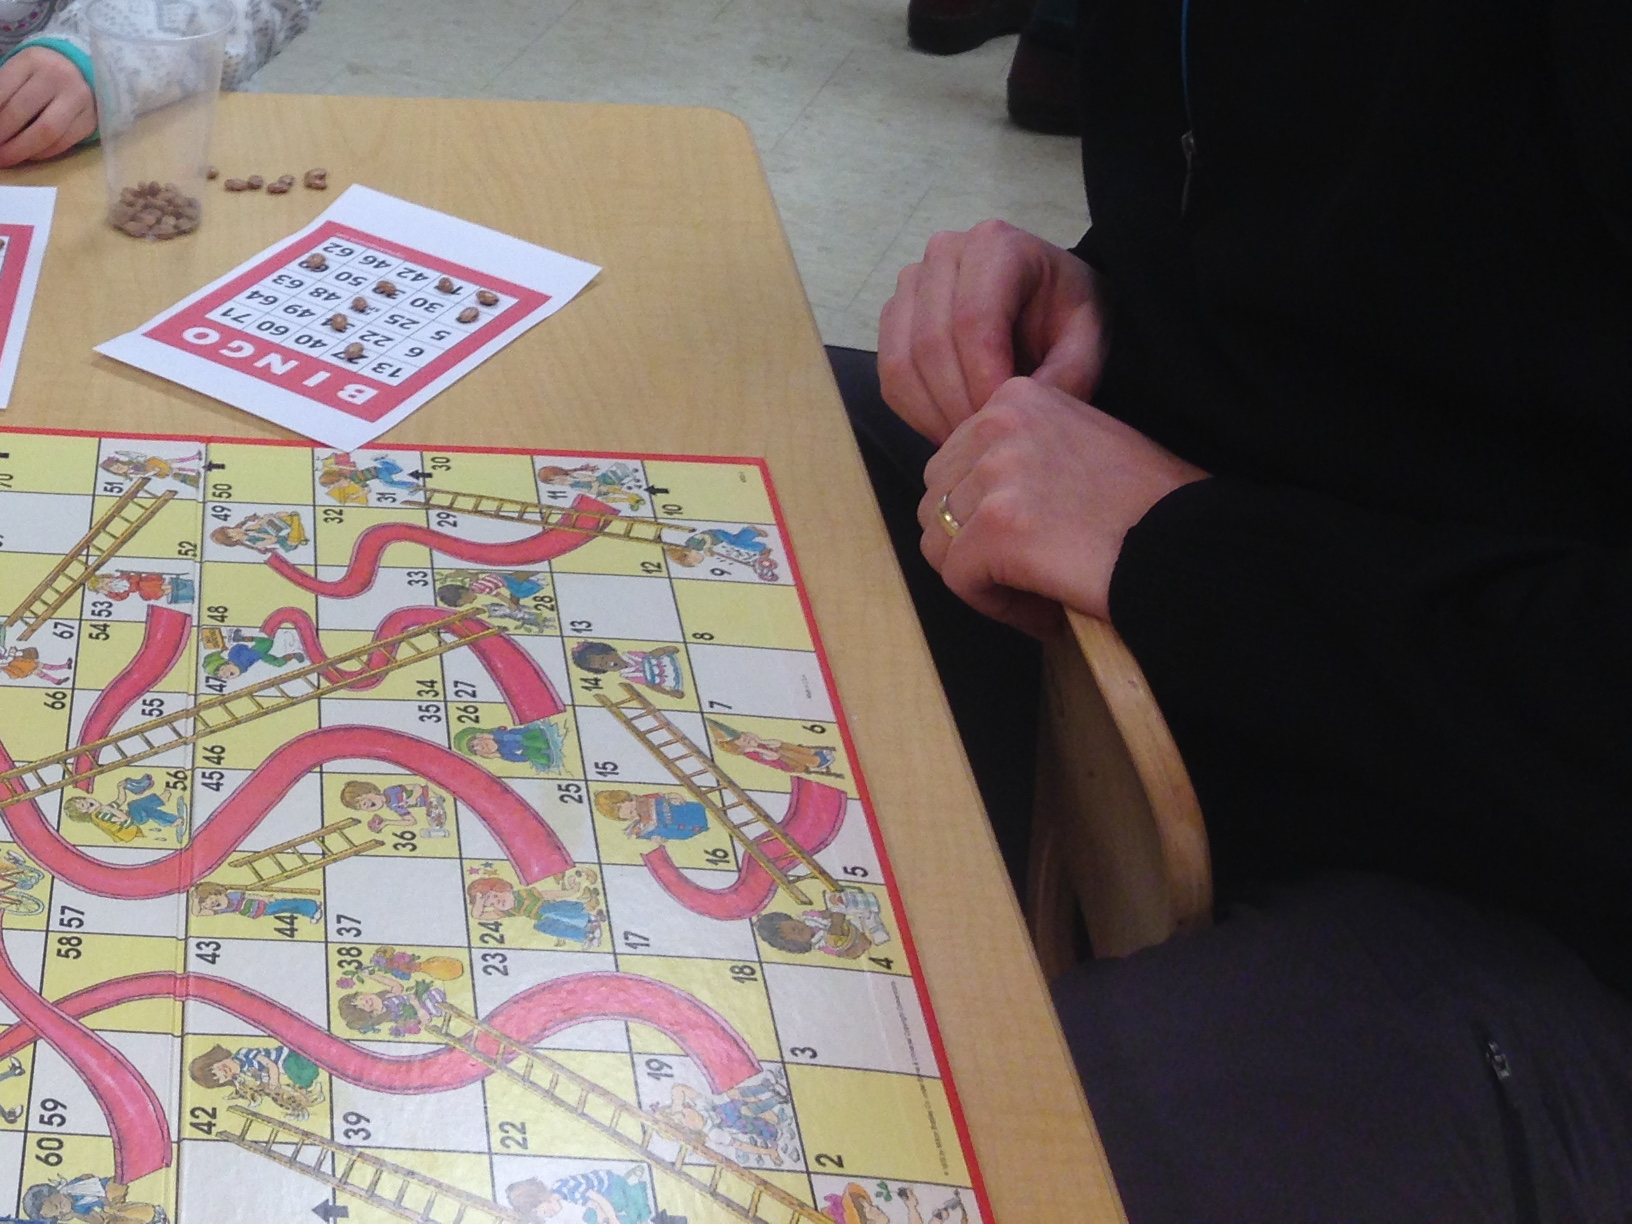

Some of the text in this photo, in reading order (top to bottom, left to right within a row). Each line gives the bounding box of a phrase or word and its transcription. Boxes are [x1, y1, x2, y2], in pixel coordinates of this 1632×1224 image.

[322, 242, 355, 258] 62
[358, 255, 392, 271] 46
[397, 267, 430, 283] 42
[335, 271, 444, 313] 30 50
[272, 274, 452, 341] 5 25 48 63
[244, 290, 425, 358] 6 22 49 64
[220, 307, 404, 379] 13 40 60 71
[182, 327, 380, 405] BINGO
[431, 456, 451, 471] 30
[212, 483, 232, 499] 50
[211, 504, 232, 521] 49
[323, 508, 344, 524] 32
[662, 503, 683, 515] 10
[437, 511, 458, 528] 29
[178, 540, 198, 557] 52
[640, 561, 662, 575] 12
[408, 570, 428, 587] 33
[91, 600, 113, 618] 53
[207, 605, 228, 622] 48
[53, 621, 74, 639] 67
[89, 623, 110, 641] 54
[570, 619, 593, 634] 13
[691, 632, 715, 641] 8
[416, 679, 439, 698] 34
[454, 680, 477, 698] 27
[44, 690, 66, 710] 66
[141, 697, 164, 717] 55
[709, 700, 732, 710] 7
[418, 704, 441, 723] 35
[457, 704, 479, 724] 26
[803, 724, 826, 734] 6
[202, 744, 226, 765] 46
[594, 761, 619, 777] 15
[202, 770, 225, 791] 45
[559, 783, 583, 804] 25
[393, 830, 417, 851] 36
[704, 848, 729, 866] 16
[843, 866, 868, 877] 5
[59, 906, 85, 930] 57
[336, 914, 362, 937] 37
[57, 935, 83, 960] 58
[623, 931, 650, 949] 17
[196, 940, 221, 964] 43
[482, 951, 509, 976] 23
[868, 957, 894, 969] 4
[731, 964, 759, 983] 18
[791, 1046, 818, 1058] 3
[39, 1098, 67, 1127] 59
[190, 1107, 217, 1135] 42
[343, 1112, 371, 1141] 39
[499, 1121, 527, 1150] 22
[36, 1137, 64, 1166] 60
[815, 1153, 845, 1168] 2
